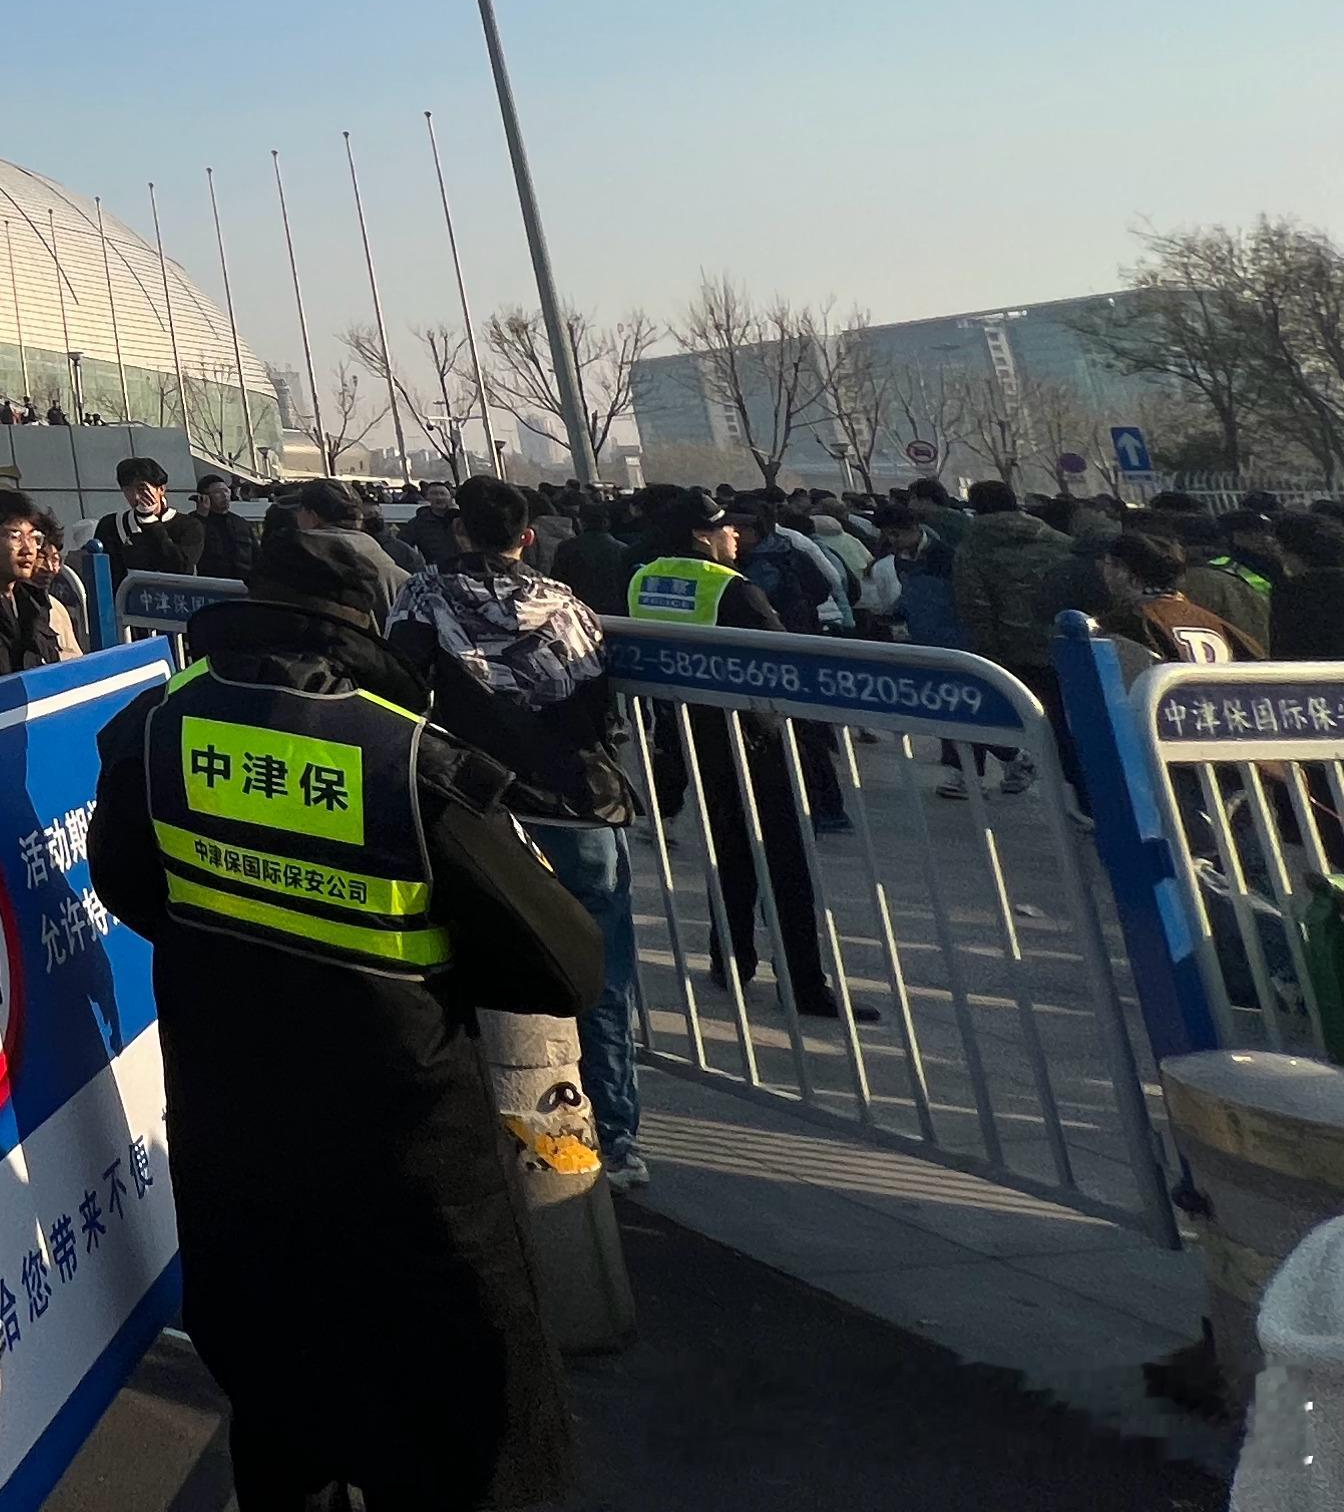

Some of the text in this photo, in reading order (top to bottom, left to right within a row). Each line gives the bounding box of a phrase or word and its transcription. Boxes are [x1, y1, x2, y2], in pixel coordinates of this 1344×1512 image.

[140, 589, 217, 614] 中津保国
[1164, 696, 1344, 737] 中津保国际保
[191, 744, 349, 812] 中津保
[18, 800, 97, 890] 活动期
[194, 838, 368, 905] 中津保国际保安公司
